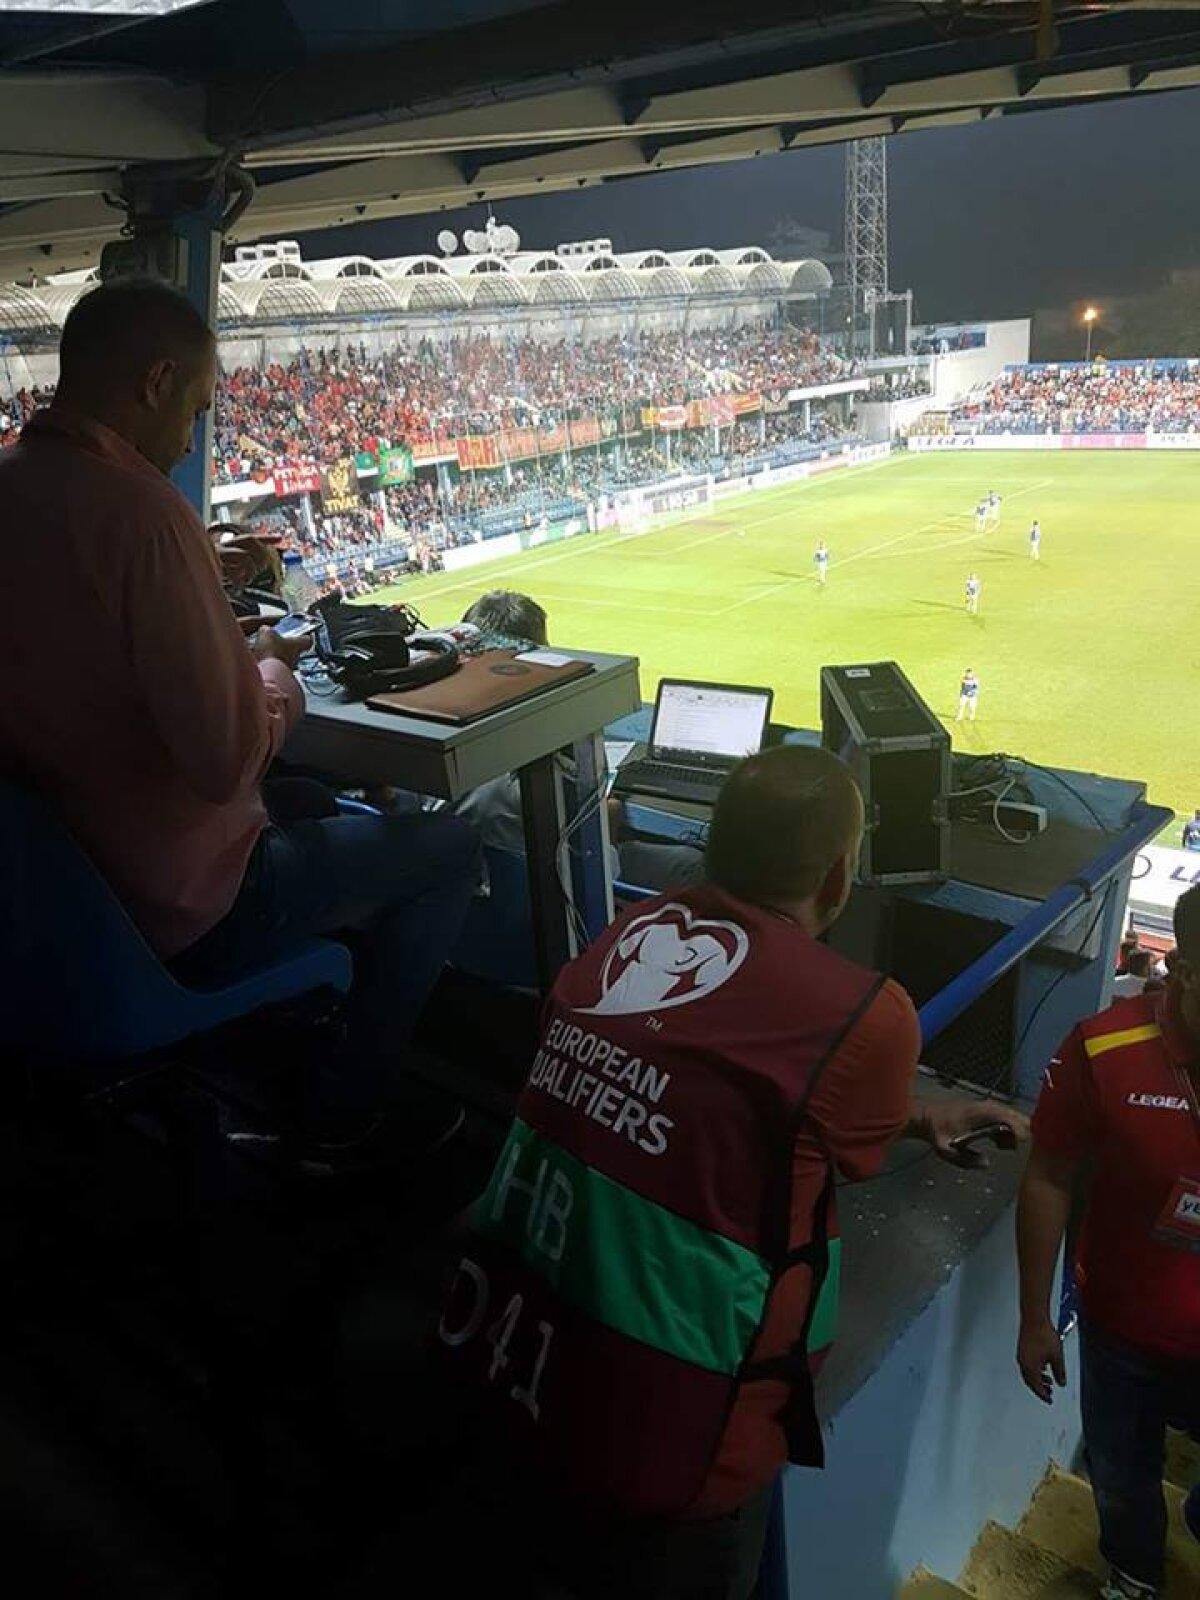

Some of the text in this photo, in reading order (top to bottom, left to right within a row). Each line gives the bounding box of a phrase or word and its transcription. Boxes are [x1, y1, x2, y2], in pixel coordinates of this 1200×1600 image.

[546, 1018, 671, 1104] EUROPEAN
[1127, 1092, 1189, 1111] LEGEA
[490, 1142, 574, 1261] HB
